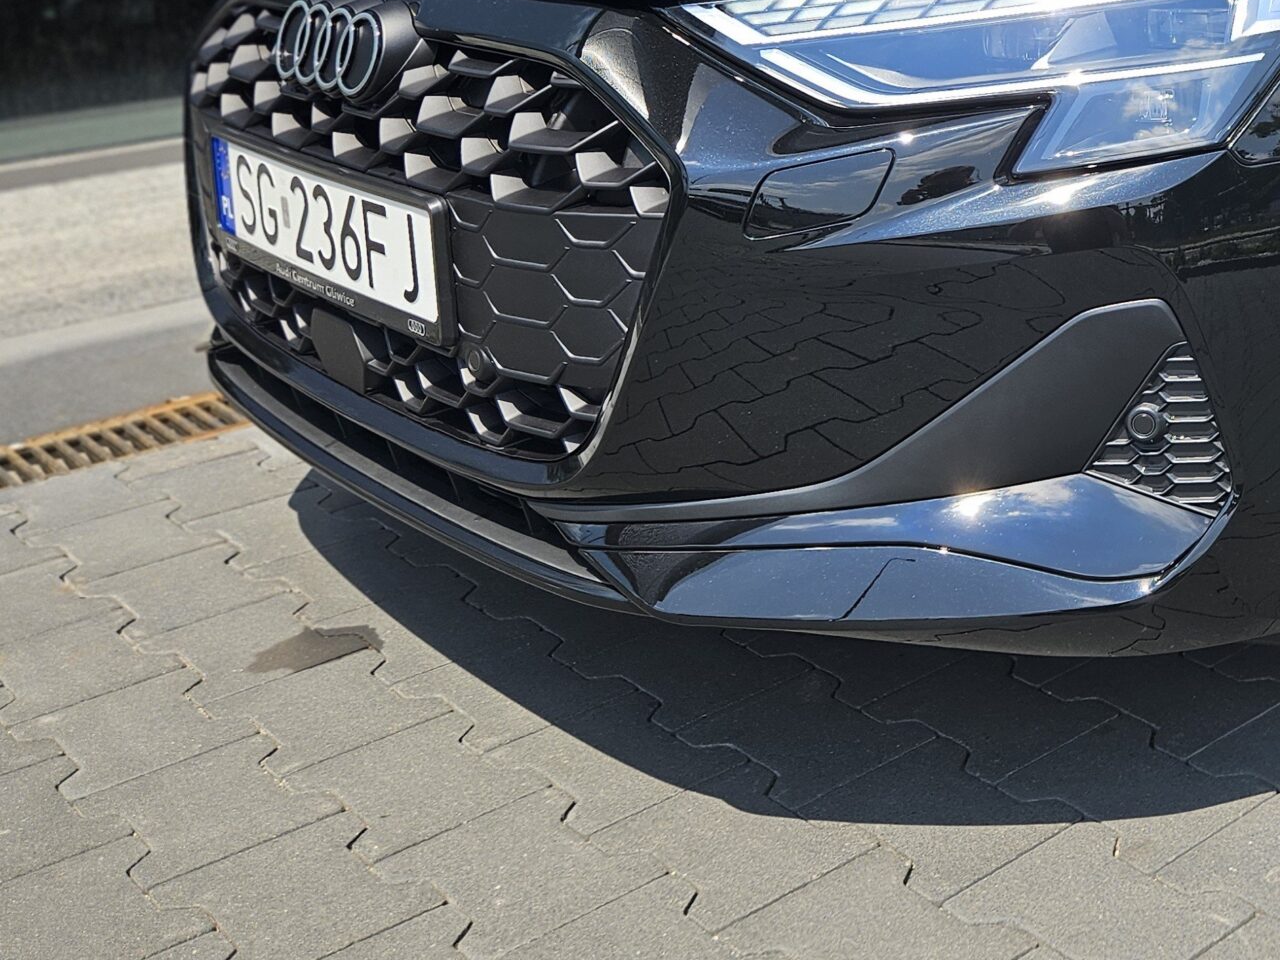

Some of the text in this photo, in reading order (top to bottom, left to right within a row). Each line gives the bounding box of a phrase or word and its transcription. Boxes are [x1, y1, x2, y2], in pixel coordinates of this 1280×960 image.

[221, 195, 235, 220] PL
[236, 154, 420, 304] SG 236FJ
[275, 262, 356, 307] Audi Centrum Gliwice
